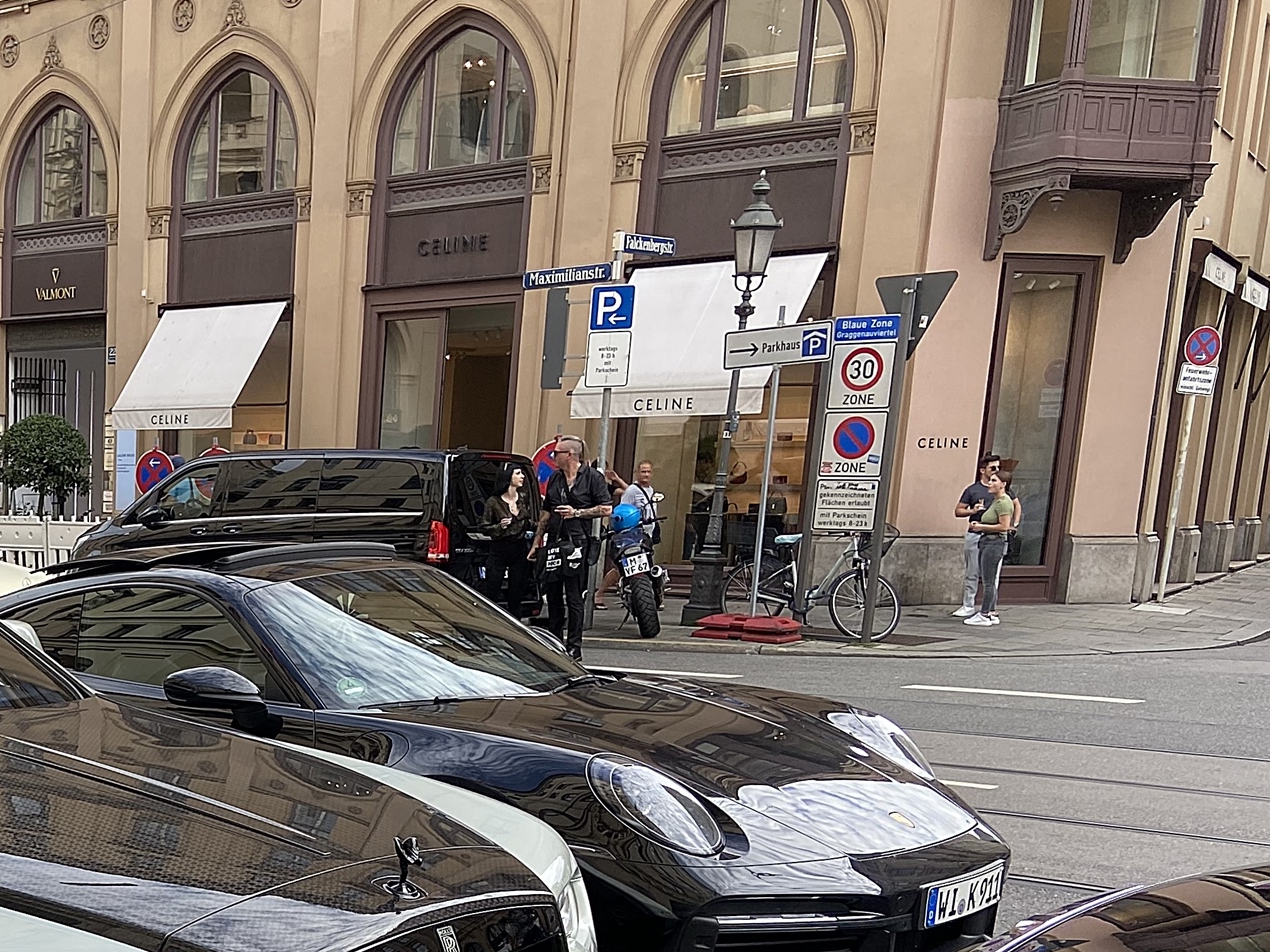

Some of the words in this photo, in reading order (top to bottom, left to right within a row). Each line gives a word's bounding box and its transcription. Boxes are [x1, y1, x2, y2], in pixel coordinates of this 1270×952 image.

[418, 234, 489, 257] CELINE
[625, 234, 673, 255] Falckenbergstr.
[530, 267, 606, 285] Maximilianstr.
[35, 286, 76, 300] VALMONT
[842, 320, 867, 329] Blaue
[871, 319, 893, 329] Zone
[837, 329, 897, 340] Graggenauviertel
[762, 340, 800, 353] Parkhaus
[849, 360, 874, 379] 30
[634, 397, 693, 411] CELINE
[843, 394, 875, 405] ZONE
[151, 414, 189, 425] CELINE
[917, 437, 969, 449] CELINE
[834, 462, 866, 473] ZONE
[638, 562, 647, 571] 67
[938, 888, 958, 920] WI
